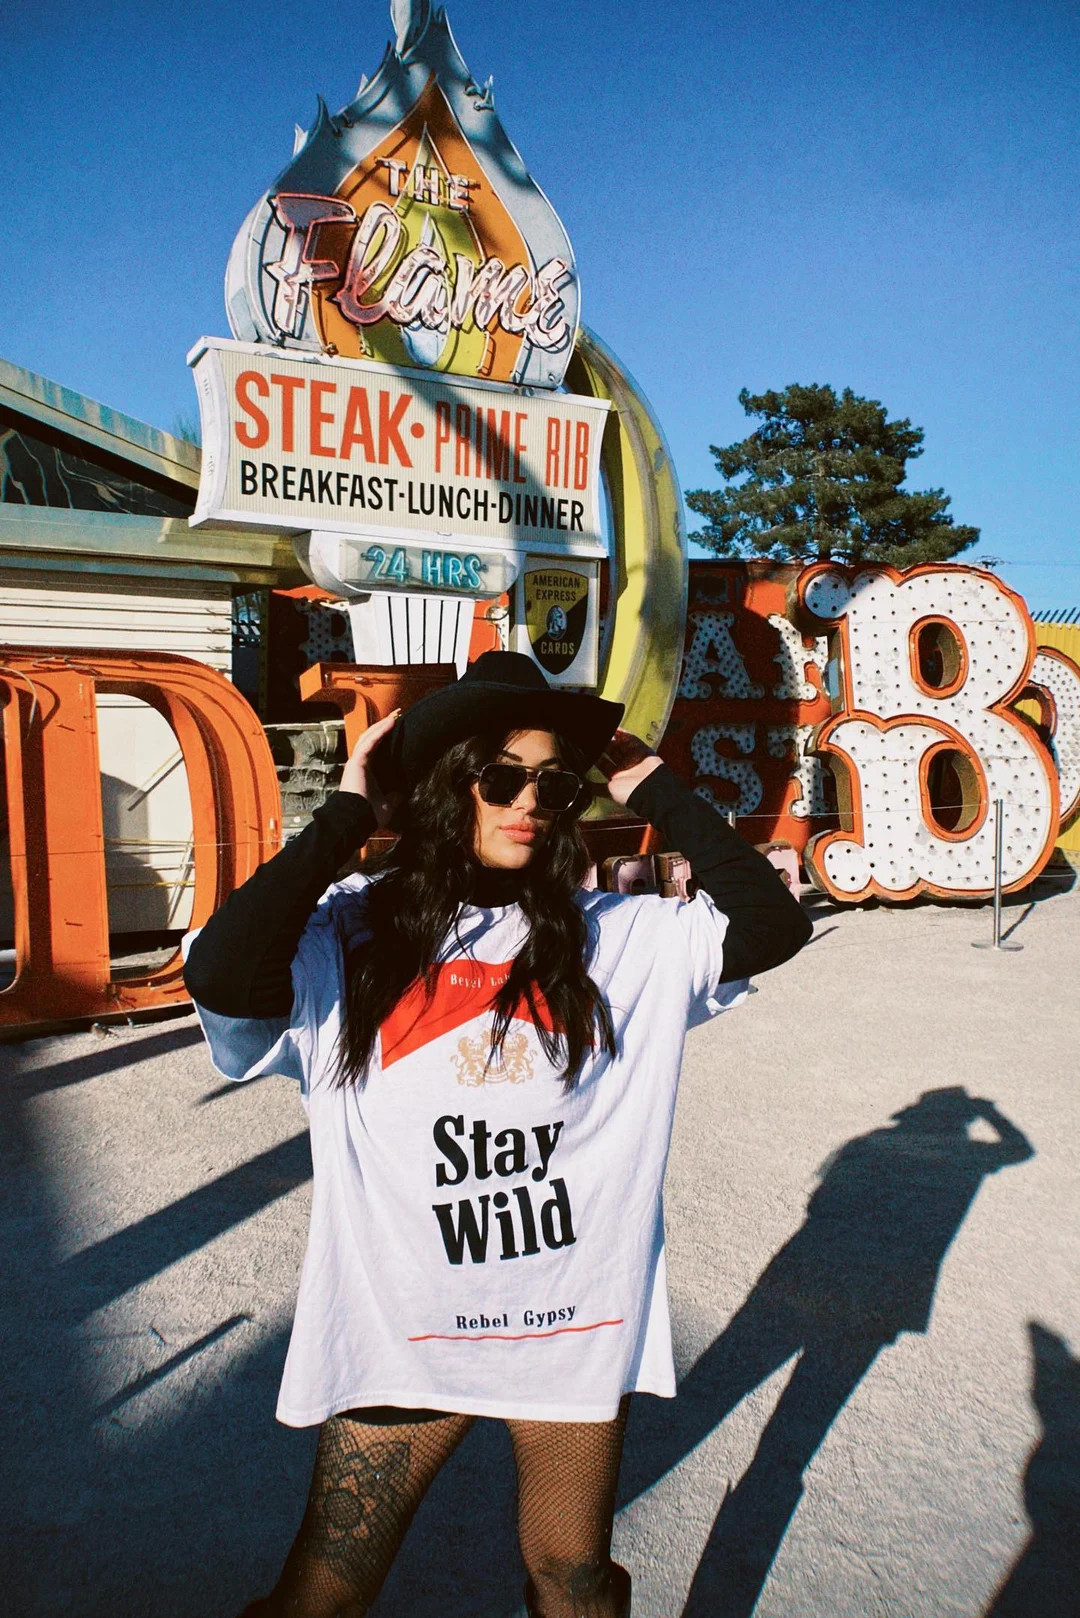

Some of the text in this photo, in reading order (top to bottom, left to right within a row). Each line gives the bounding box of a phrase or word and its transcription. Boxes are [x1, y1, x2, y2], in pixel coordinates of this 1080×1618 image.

[383, 158, 469, 210] THE
[434, 401, 528, 483] PRIME
[545, 417, 590, 490] RIB
[367, 545, 481, 590] 24 HRS
[532, 574, 580, 588] AMERICAN
[536, 589, 577, 602] EXPRESS
[540, 641, 575, 655] CARDS
[432, 1114, 565, 1187] Stay
[432, 1177, 577, 1266] Wild
[456, 1305, 576, 1329] Rebel Gypsy
